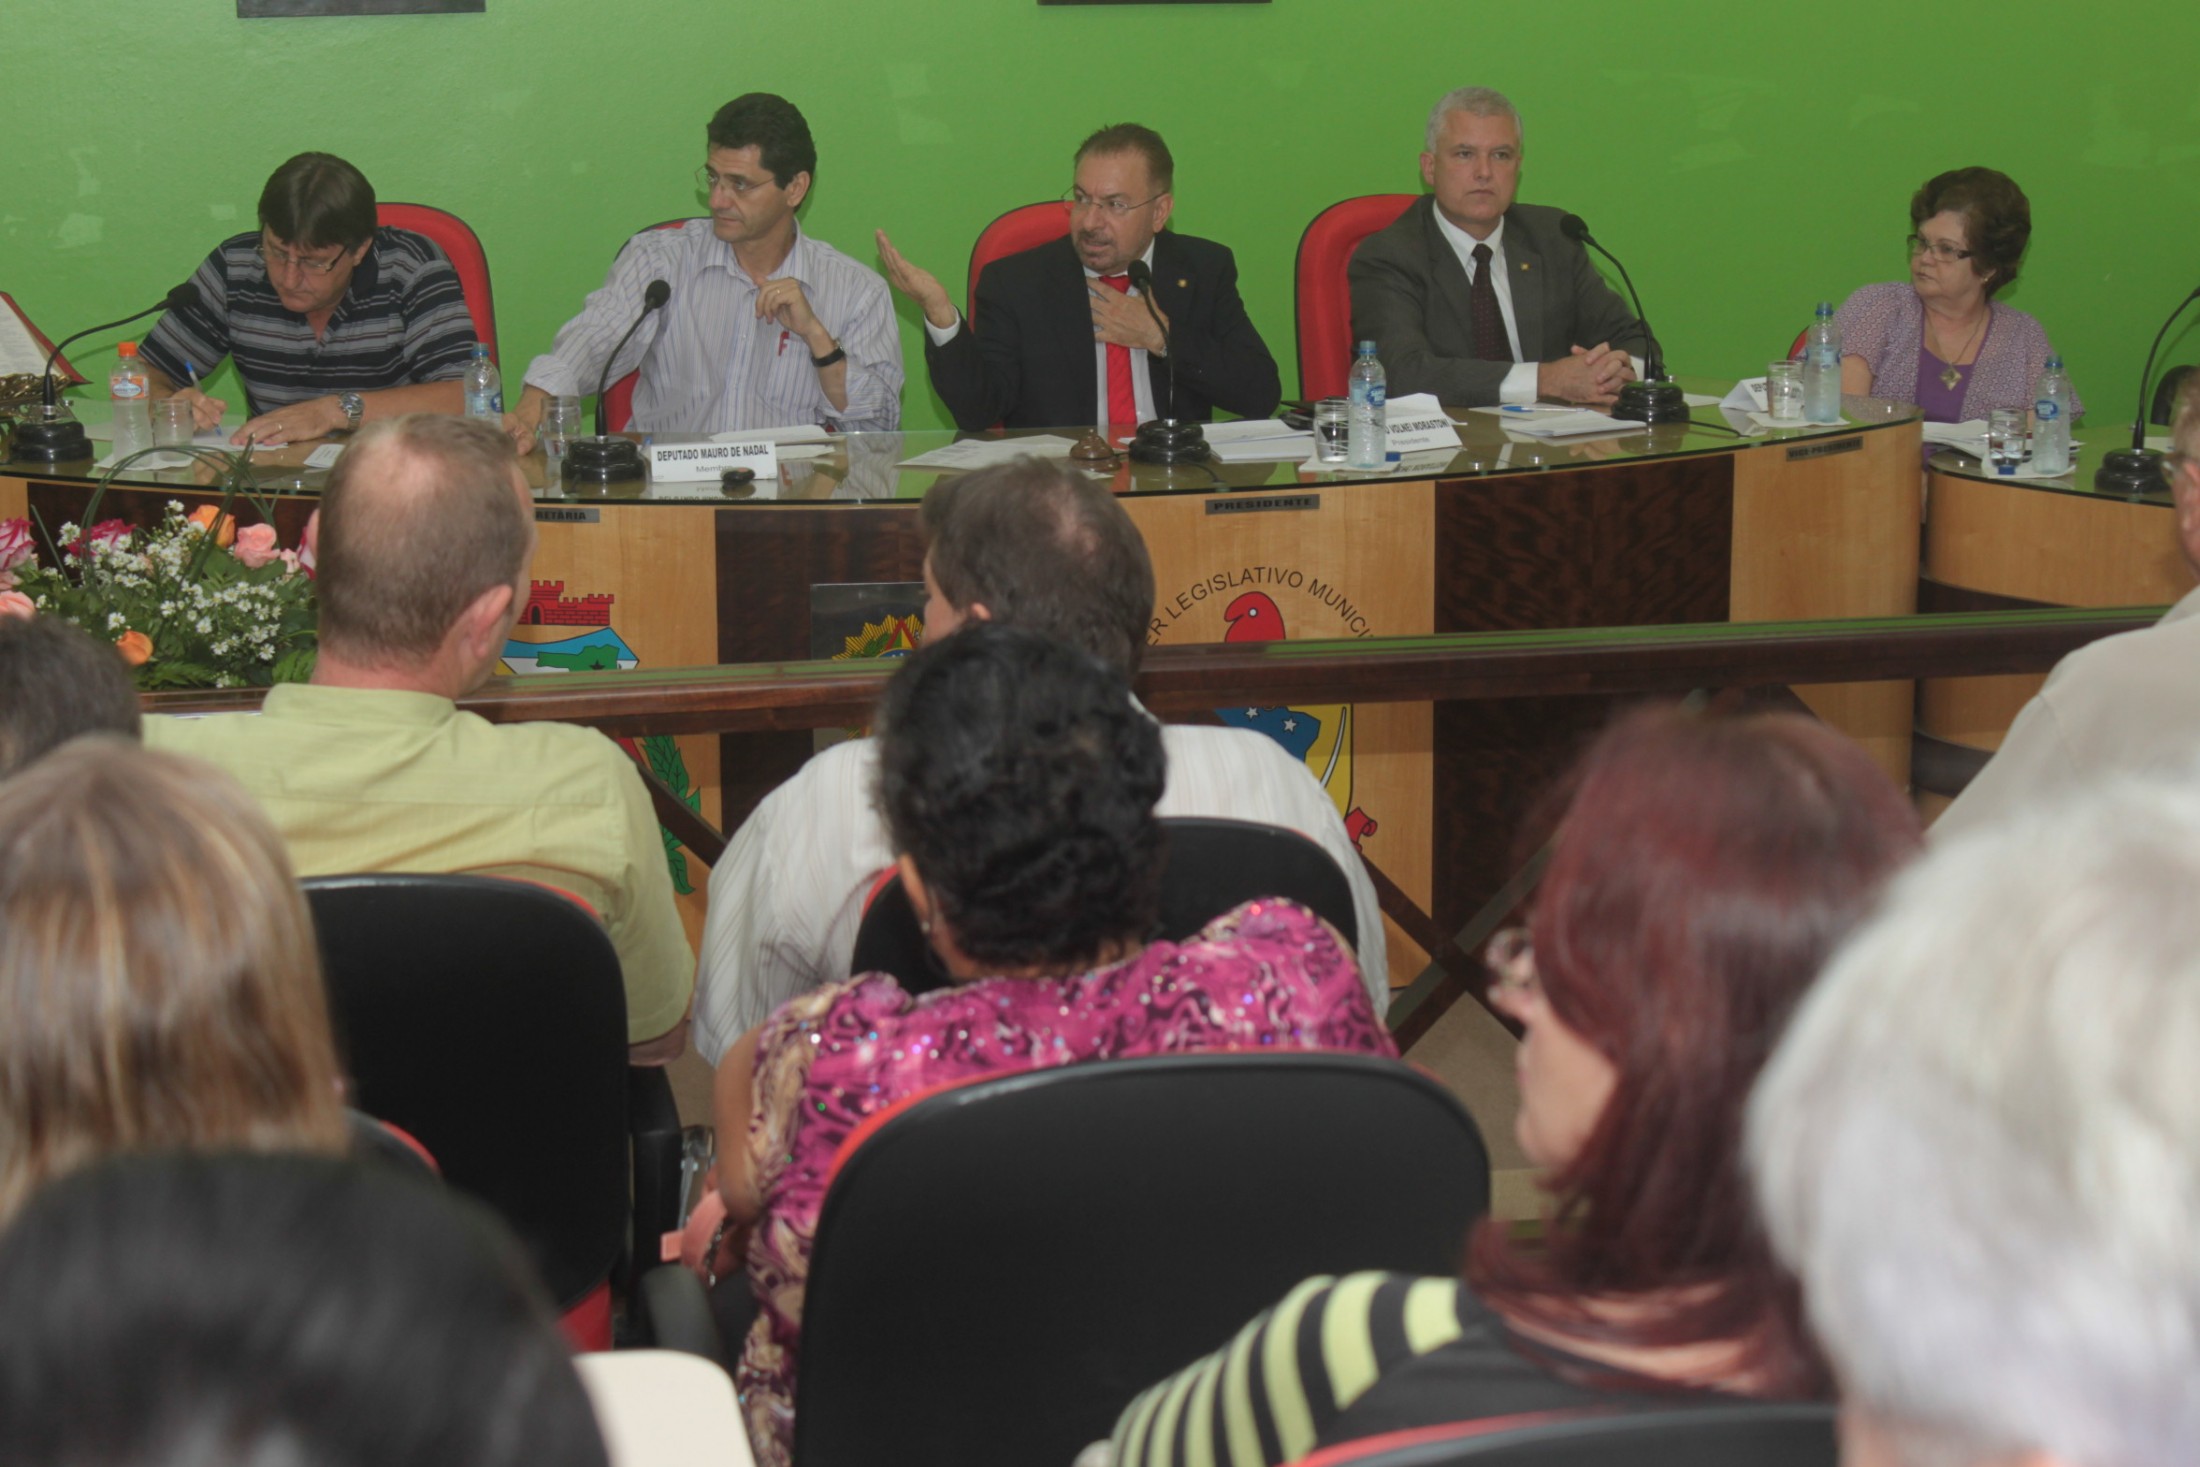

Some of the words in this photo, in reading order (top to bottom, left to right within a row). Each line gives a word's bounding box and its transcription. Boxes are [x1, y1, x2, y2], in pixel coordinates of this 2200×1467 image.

[657, 449, 699, 462] DEPUTADO
[700, 447, 729, 459] MAURO
[731, 446, 741, 457] DE
[743, 444, 769, 456] NADAL
[1213, 498, 1312, 510] PRESIDENTE
[1164, 566, 1304, 620] LEGISLATIVO
[1308, 578, 1374, 638] MUNICI
